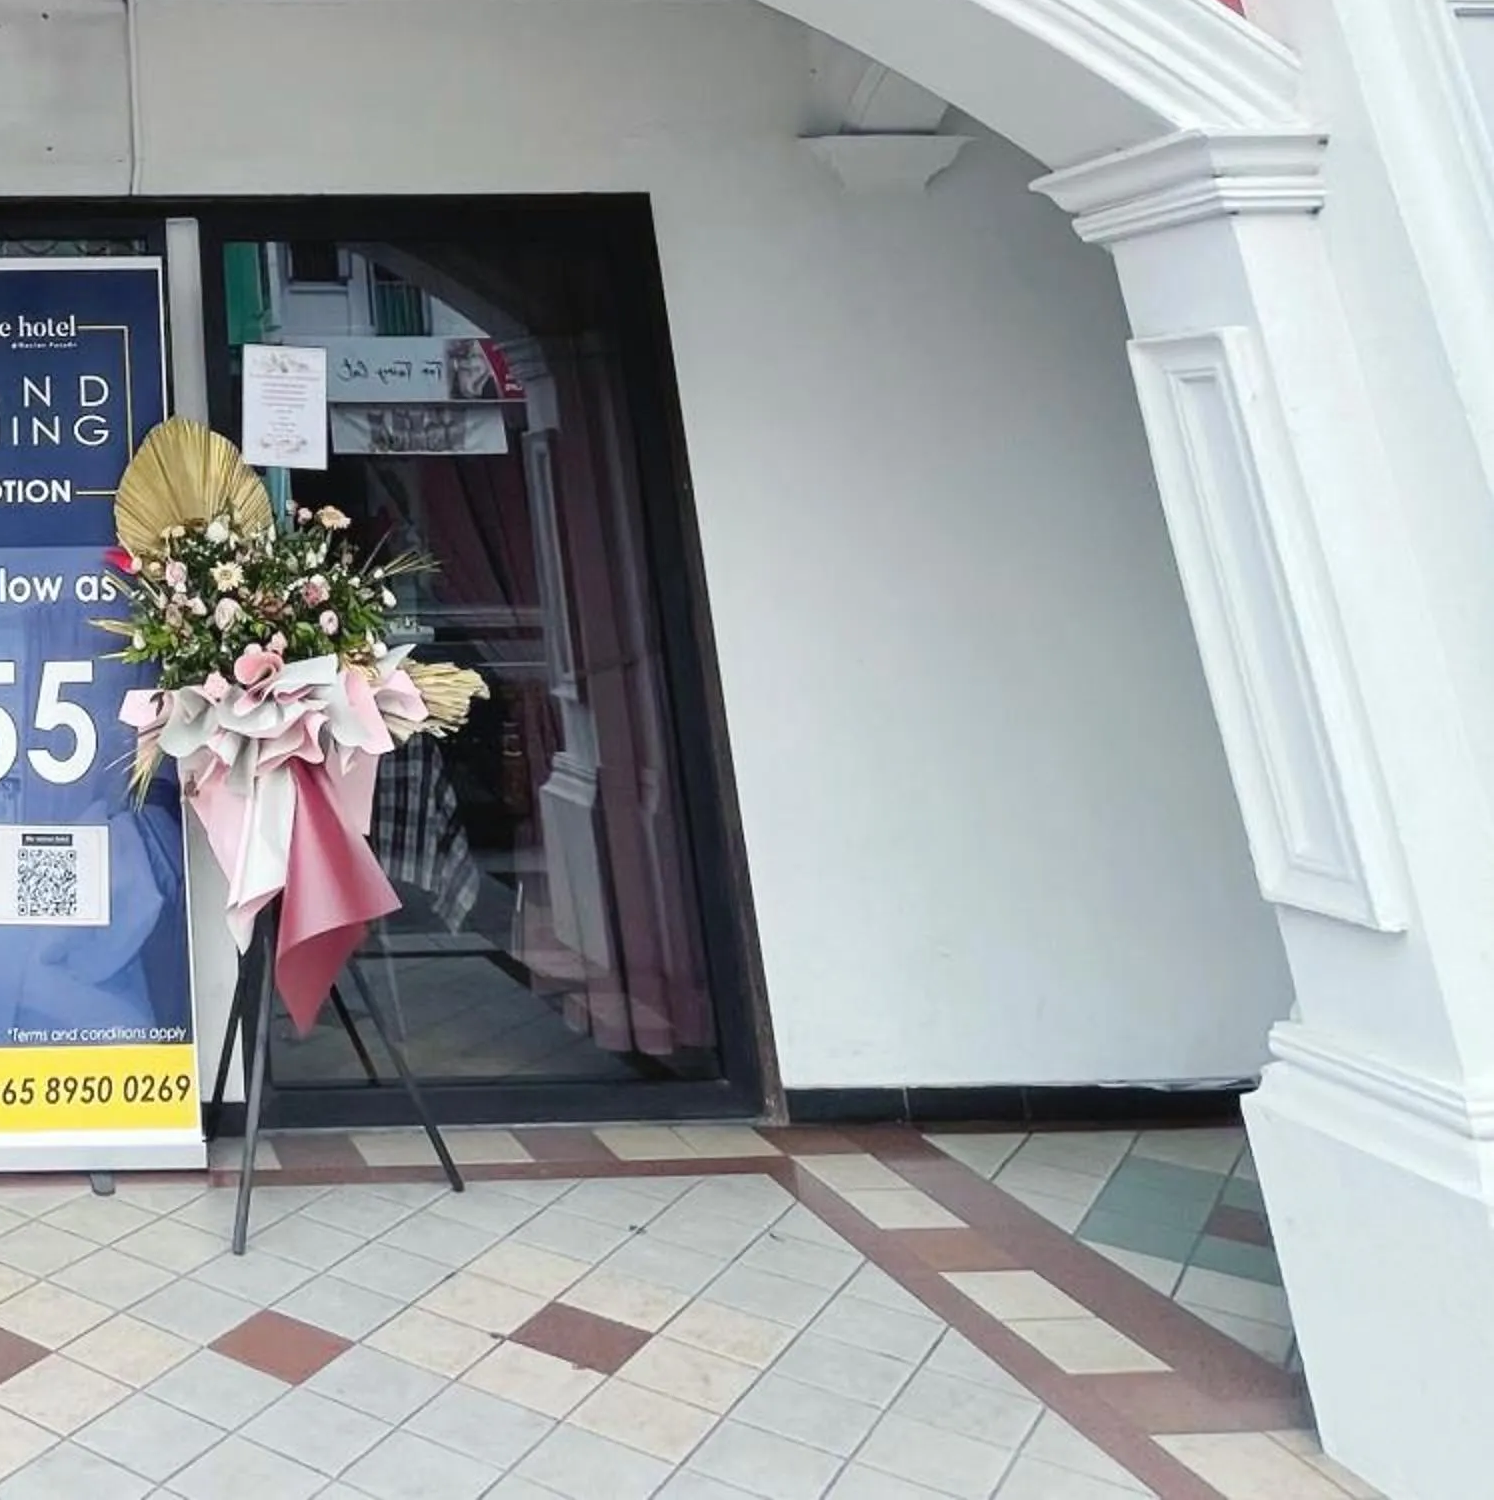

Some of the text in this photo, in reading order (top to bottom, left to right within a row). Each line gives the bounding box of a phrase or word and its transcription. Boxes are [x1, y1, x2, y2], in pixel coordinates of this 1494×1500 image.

[18, 314, 77, 338] hotel
[75, 573, 117, 602] as
[51, 1028, 77, 1041] and
[80, 1026, 145, 1041] conditions
[150, 1026, 187, 1042] apply
[45, 1076, 113, 1104] 8950
[123, 1075, 191, 1103] 0269
